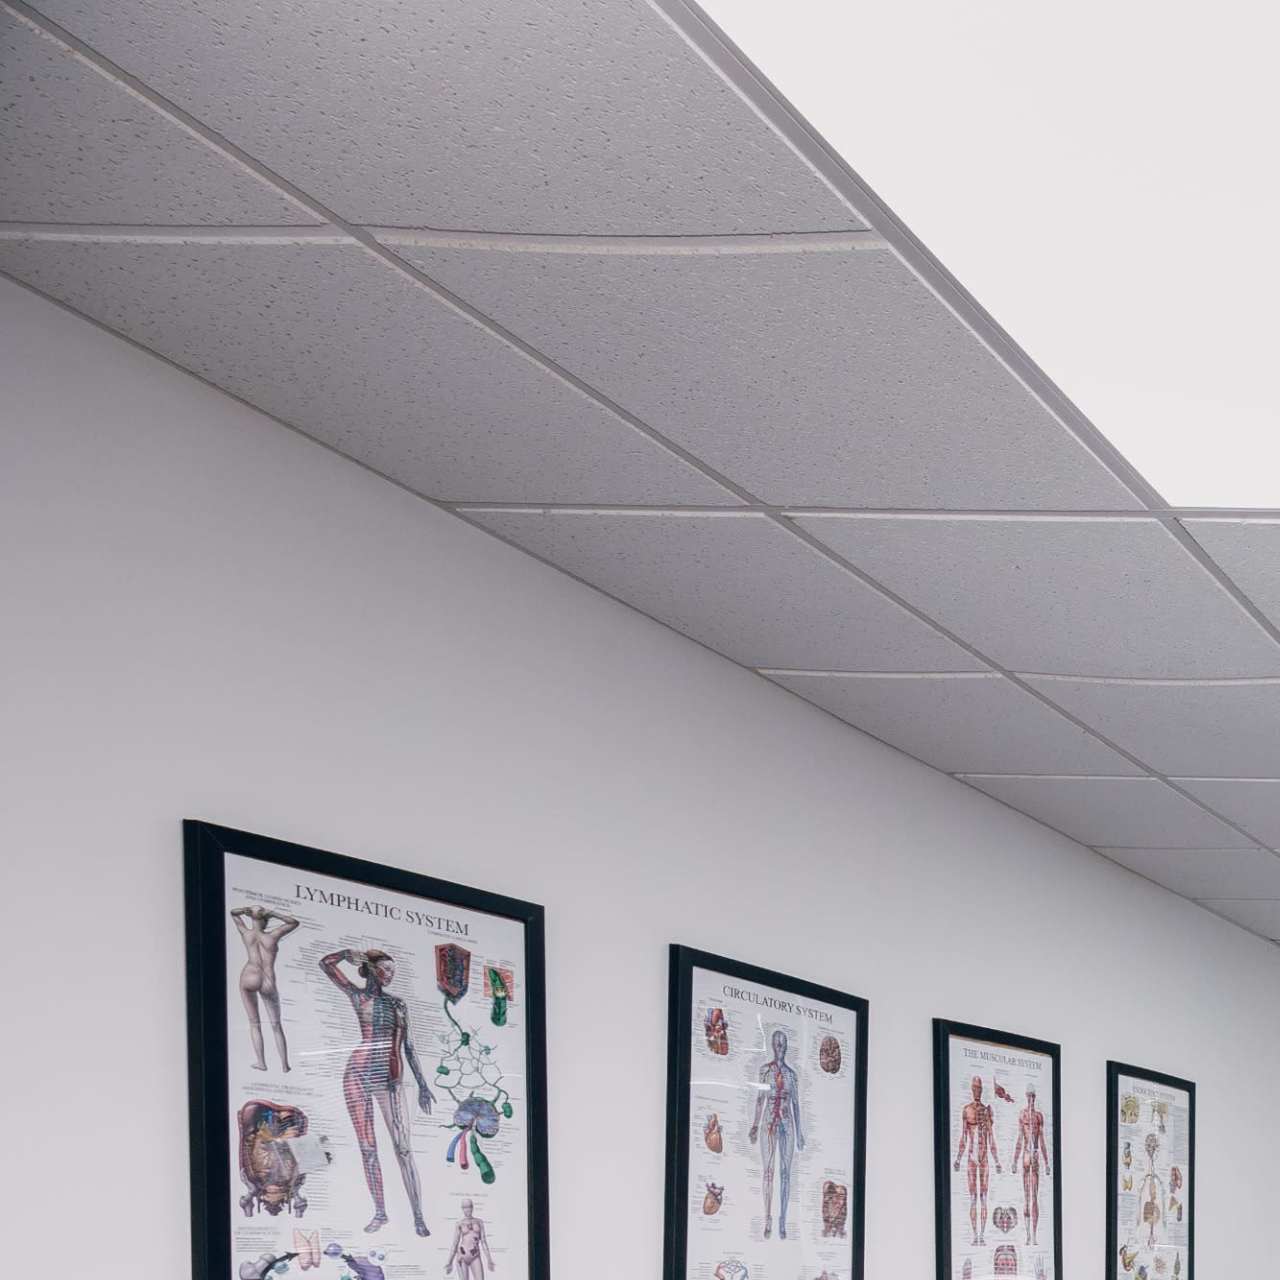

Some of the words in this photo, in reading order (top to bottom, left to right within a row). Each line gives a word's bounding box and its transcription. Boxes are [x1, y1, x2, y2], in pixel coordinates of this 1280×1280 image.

[295, 885, 401, 921] LYMPHATIC
[405, 910, 469, 936] SYSTEM
[722, 984, 795, 1014] CIRCULATORY
[795, 1004, 834, 1025] SYSTEM
[962, 1047, 980, 1059] THE
